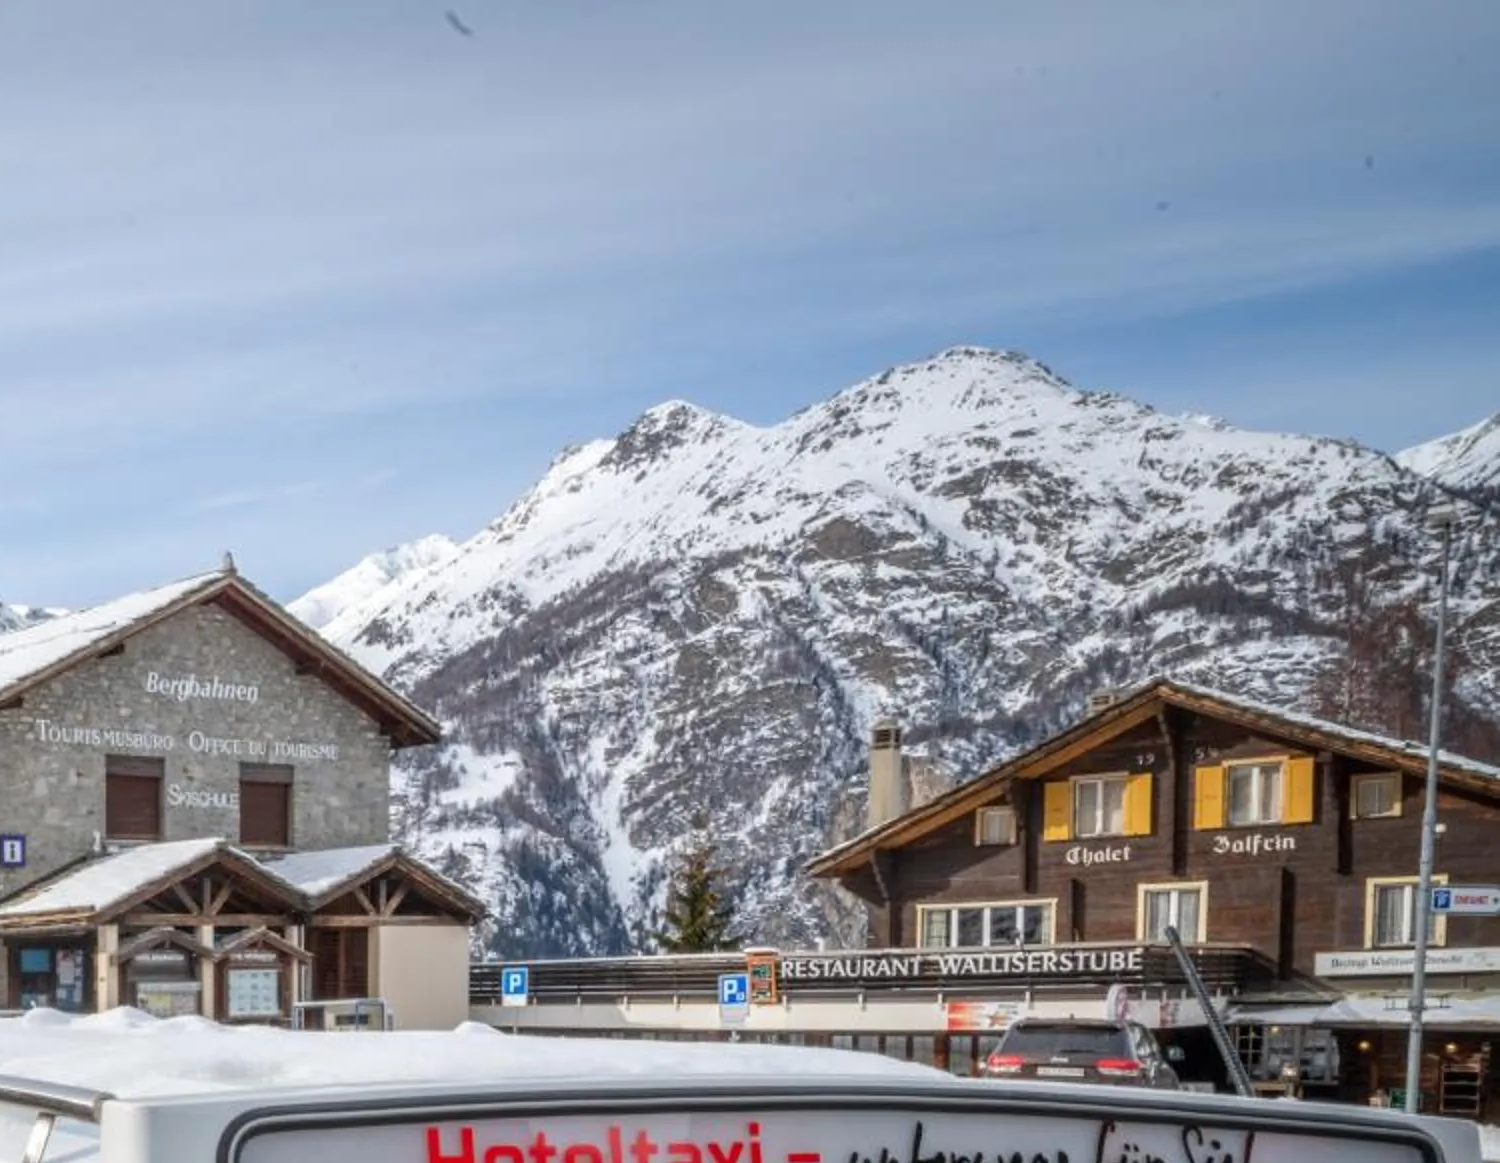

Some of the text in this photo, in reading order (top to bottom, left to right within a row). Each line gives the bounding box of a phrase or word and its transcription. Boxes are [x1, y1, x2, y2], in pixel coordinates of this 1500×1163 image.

[146, 671, 260, 704] Bergbahnen
[1066, 845, 1132, 867] Chalet
[781, 949, 1144, 979] RESTAURANT WALLISERSTUBE
[509, 973, 521, 992] P
[723, 979, 737, 1002] P
